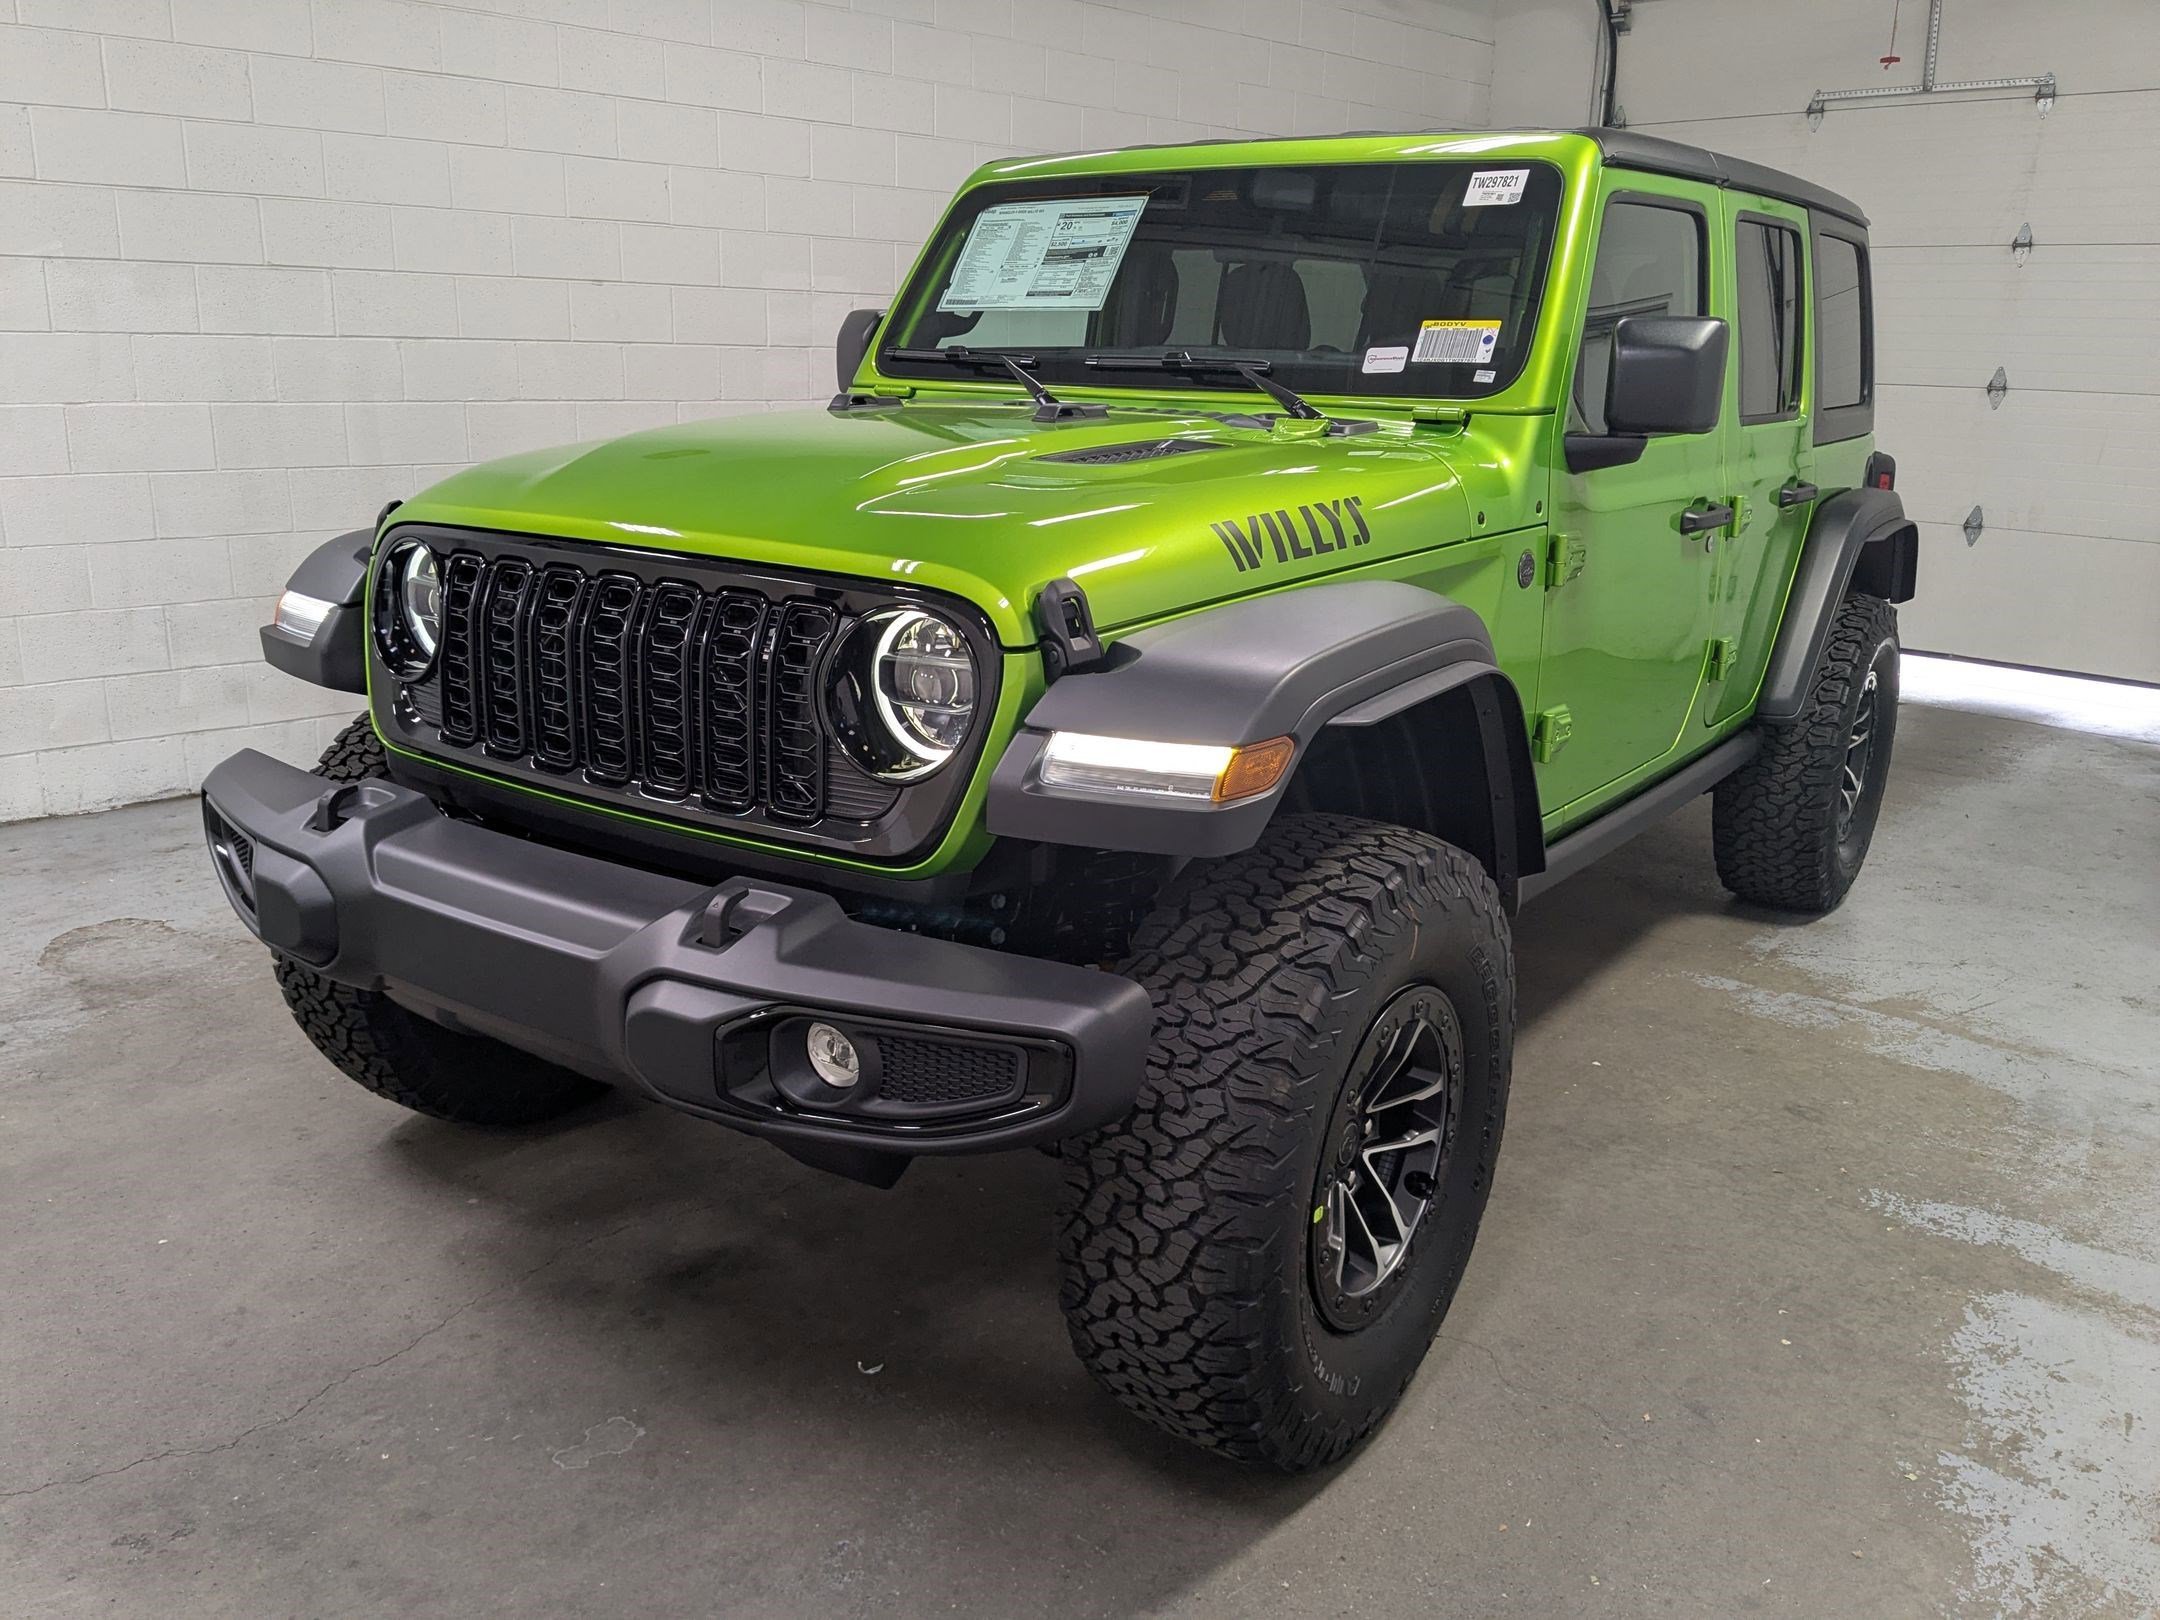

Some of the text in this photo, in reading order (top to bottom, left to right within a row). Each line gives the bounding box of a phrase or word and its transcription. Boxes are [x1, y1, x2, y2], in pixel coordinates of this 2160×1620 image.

[1472, 175, 1520, 189] TW297821
[1060, 221, 1073, 230] 20
[1210, 496, 1371, 572] WILLYS
